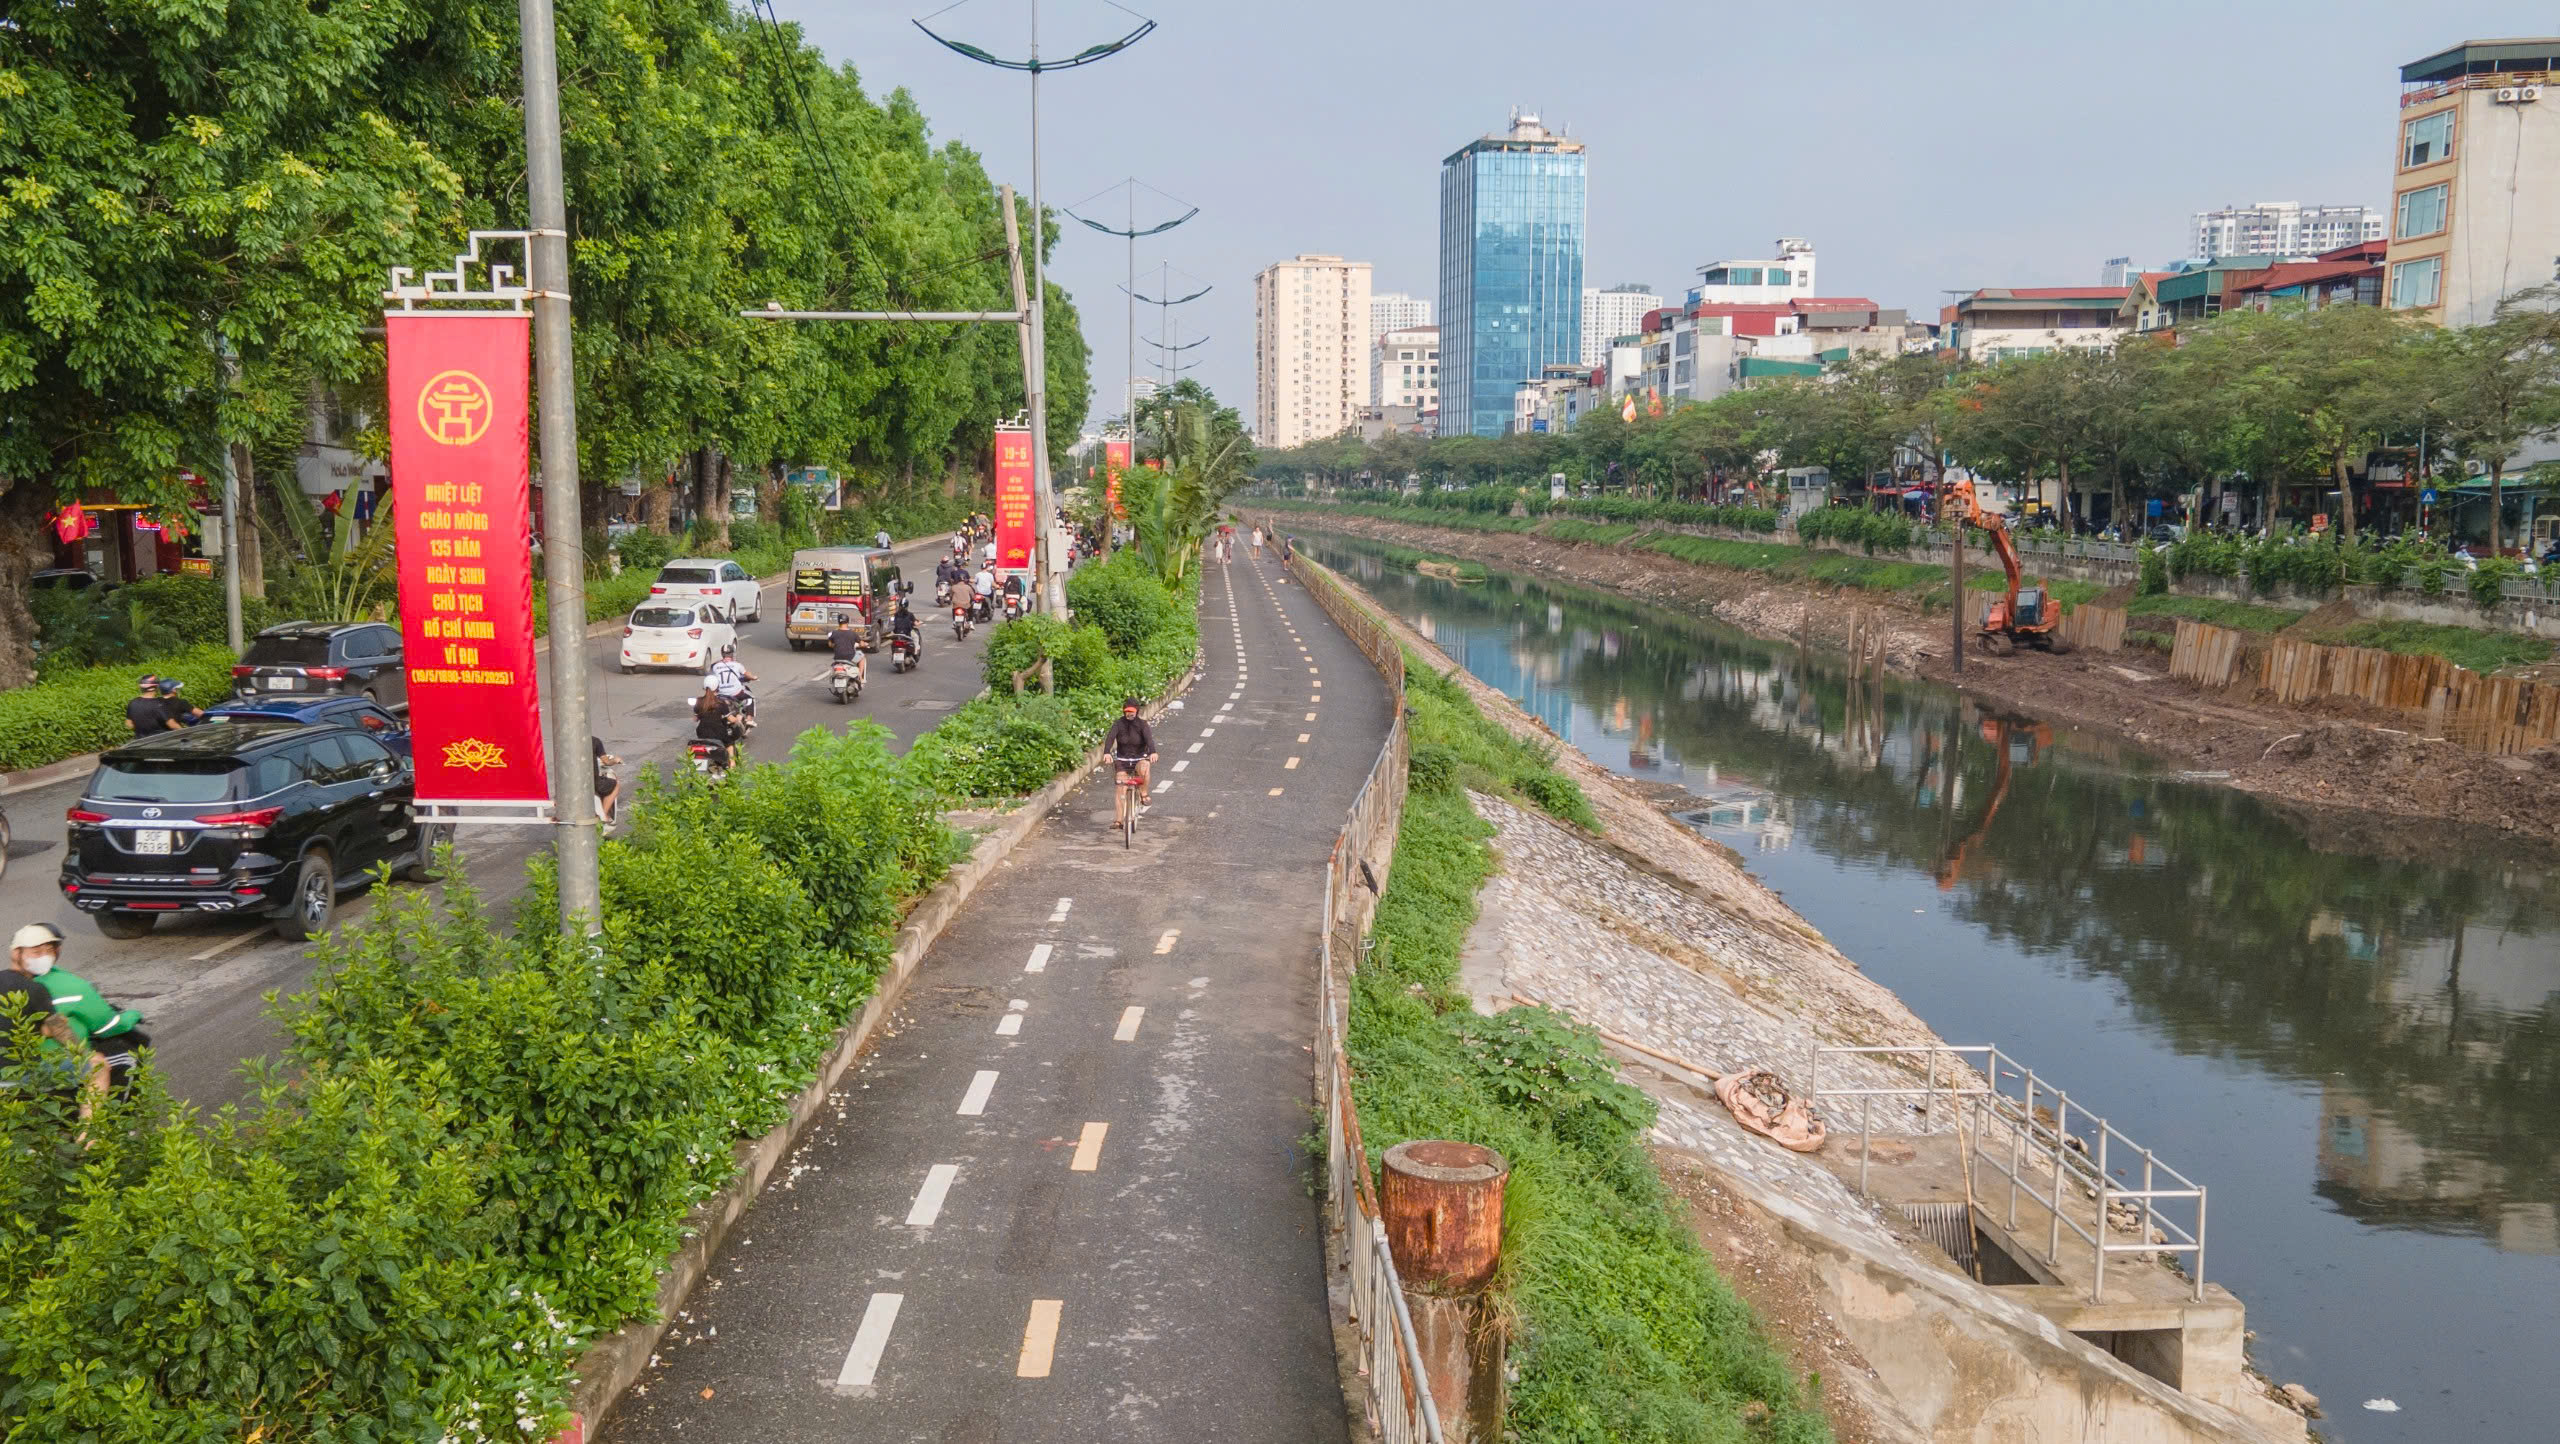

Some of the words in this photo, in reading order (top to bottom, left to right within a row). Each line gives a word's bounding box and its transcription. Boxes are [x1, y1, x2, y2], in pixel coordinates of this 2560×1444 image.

[425, 481, 457, 506] NHIỆT
[460, 481, 482, 507] LIỆT
[420, 508, 451, 530] CHÀO
[454, 510, 489, 531] MỪNG
[430, 539, 451, 557] 135
[454, 536, 481, 557] NĂM
[426, 563, 456, 584] NGÀY
[459, 567, 486, 584] SINH
[432, 588, 456, 611] CHỦ
[458, 593, 483, 615] TỊCH
[442, 617, 462, 638] CHÍ
[464, 621, 495, 640] MINH
[444, 643, 457, 665] VĨ
[459, 647, 479, 669] ĐẠI
[719, 670, 732, 684] 17
